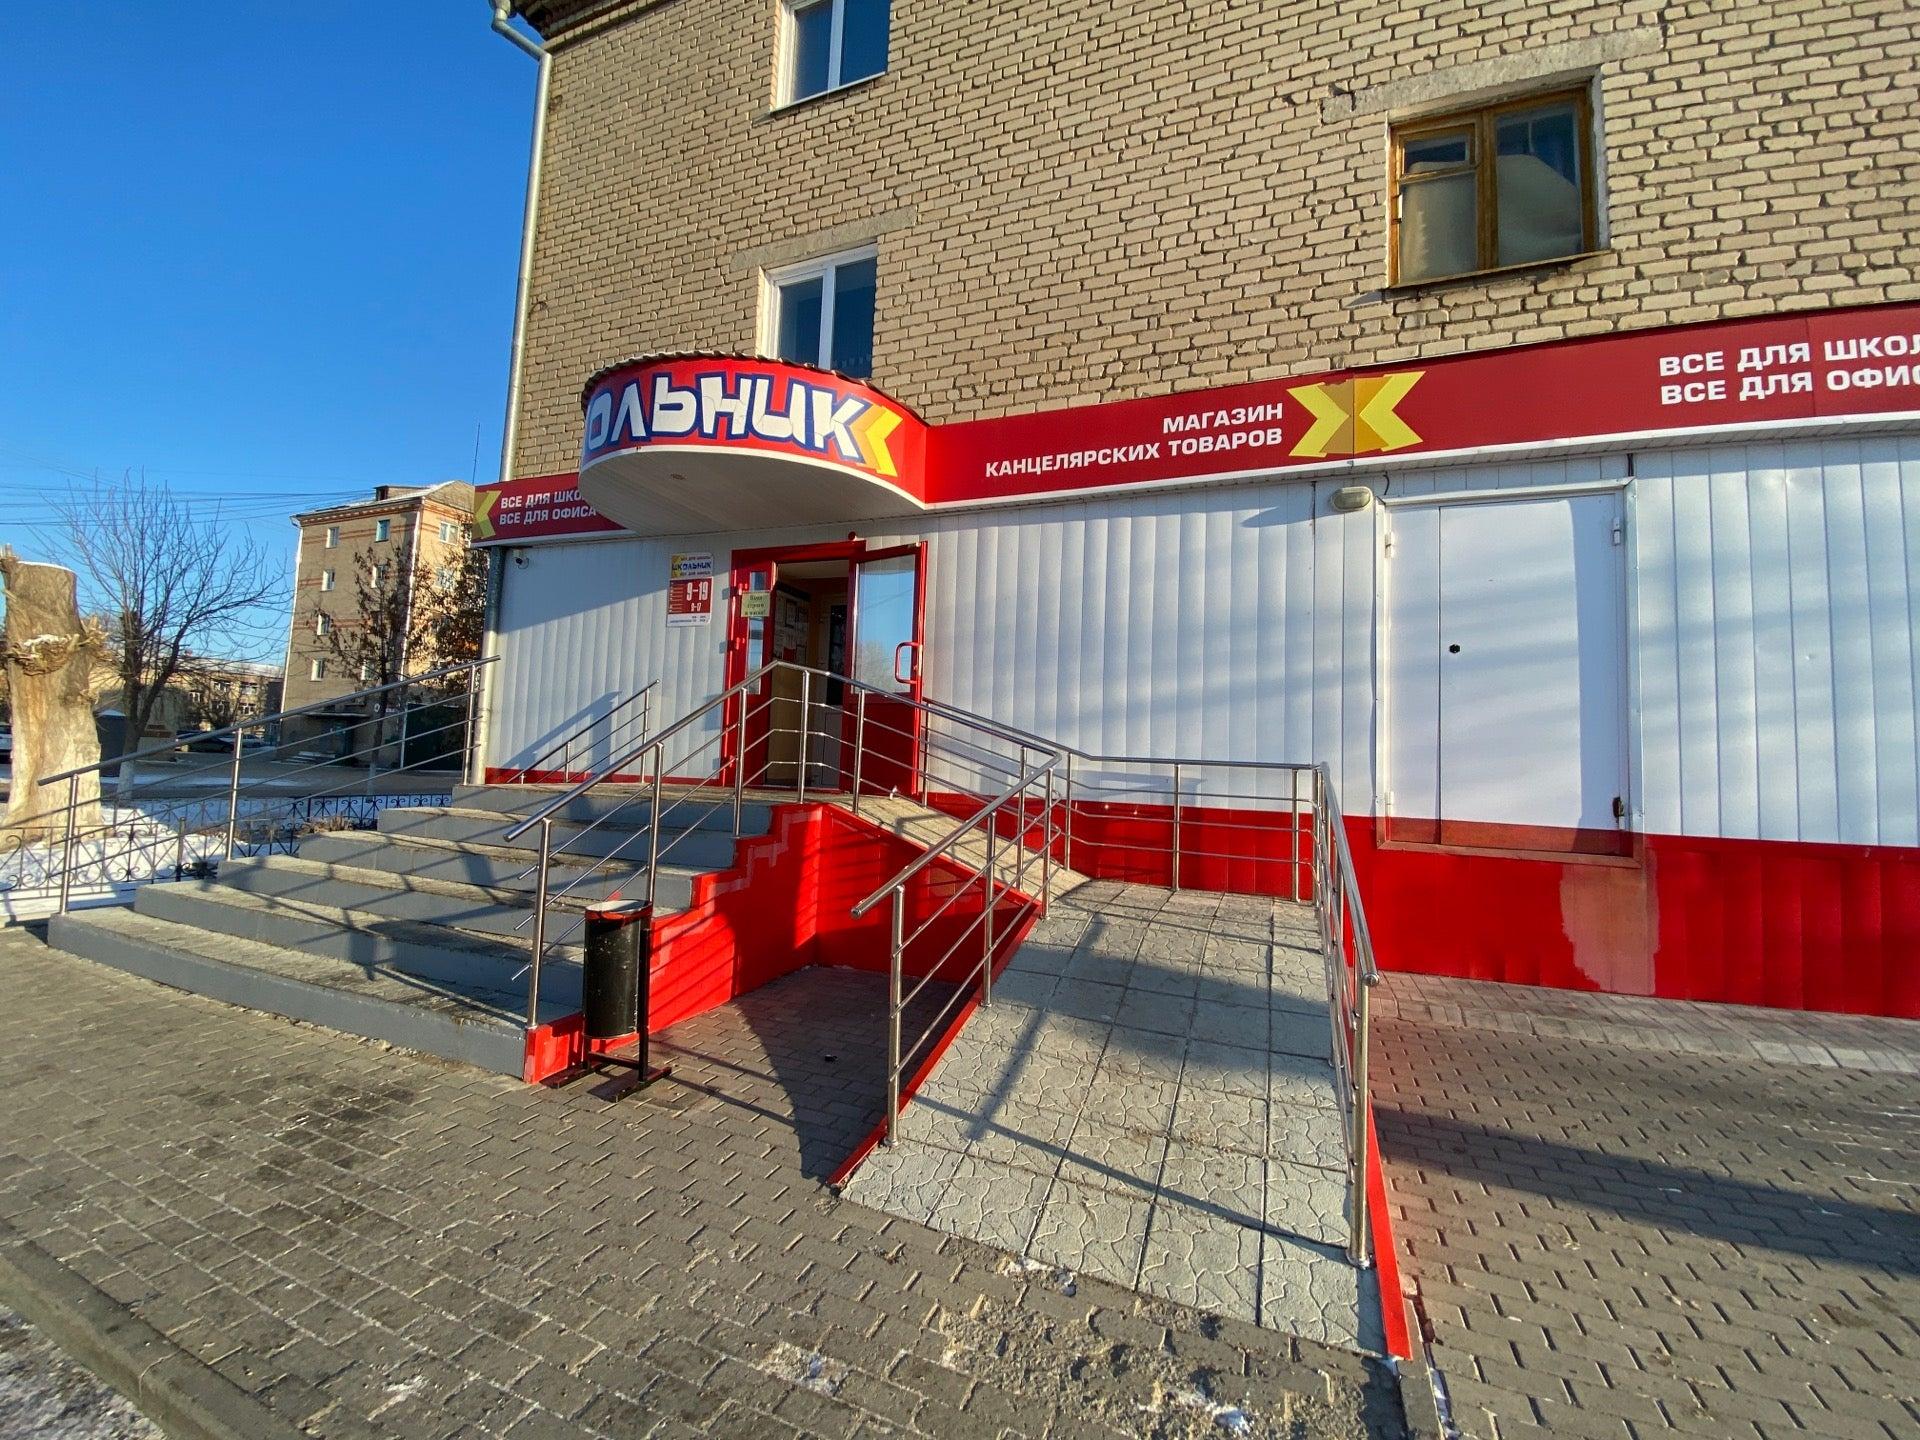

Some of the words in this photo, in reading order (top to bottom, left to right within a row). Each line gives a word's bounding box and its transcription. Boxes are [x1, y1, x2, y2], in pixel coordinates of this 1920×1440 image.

[1659, 351, 1725, 377] ВСЕ
[1737, 342, 1811, 373] ДЛЯ
[1661, 379, 1727, 405] ВСЕ
[1739, 371, 1813, 401] ДЛЯ
[1163, 403, 1284, 434] МАГАЗИН
[985, 442, 1160, 478] КАНЦЕЛЯРСКИХ
[1168, 427, 1283, 457] ТОВАРОВ
[501, 495, 522, 509] ВСЕ
[525, 492, 551, 509] ДЛЯ
[554, 489, 584, 503] ШКО
[499, 512, 521, 526] ВСЕ
[523, 508, 549, 525] ДЛЯ
[552, 505, 597, 520] ОФИСА
